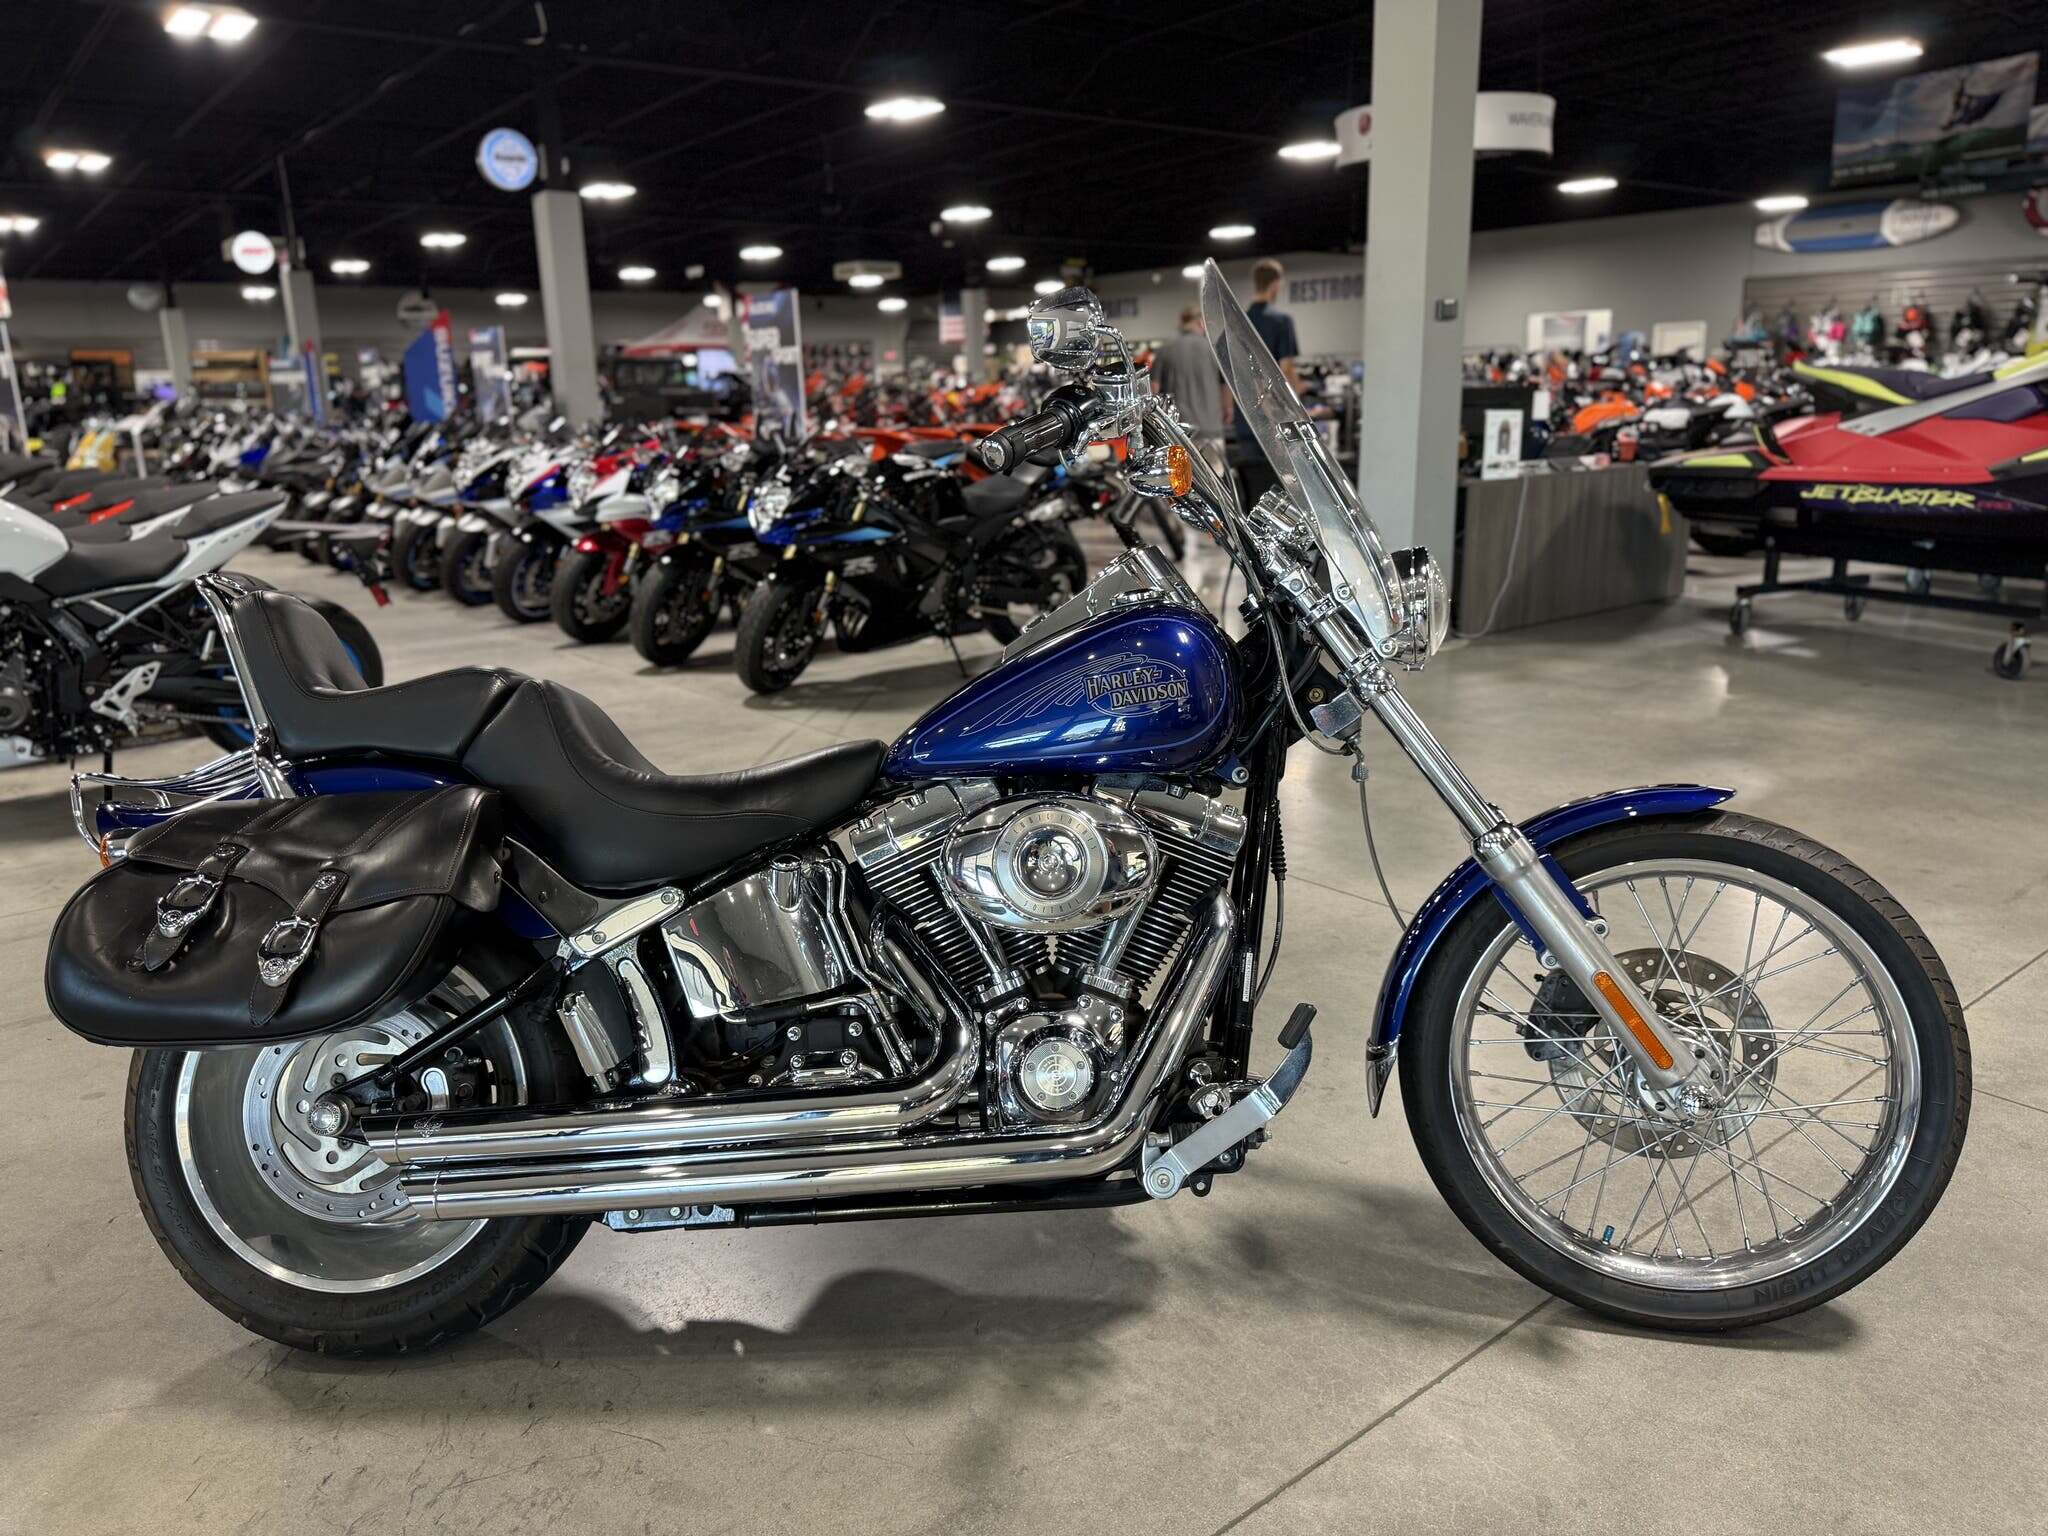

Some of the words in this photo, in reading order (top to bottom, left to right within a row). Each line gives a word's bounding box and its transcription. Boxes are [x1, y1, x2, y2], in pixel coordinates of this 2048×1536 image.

[1800, 484, 1976, 509] JETBLASTER
[1087, 667, 1162, 700] HARLEY-
[1111, 681, 1188, 709] DAVIDSON
[1750, 1261, 1833, 1301] NIGHT
